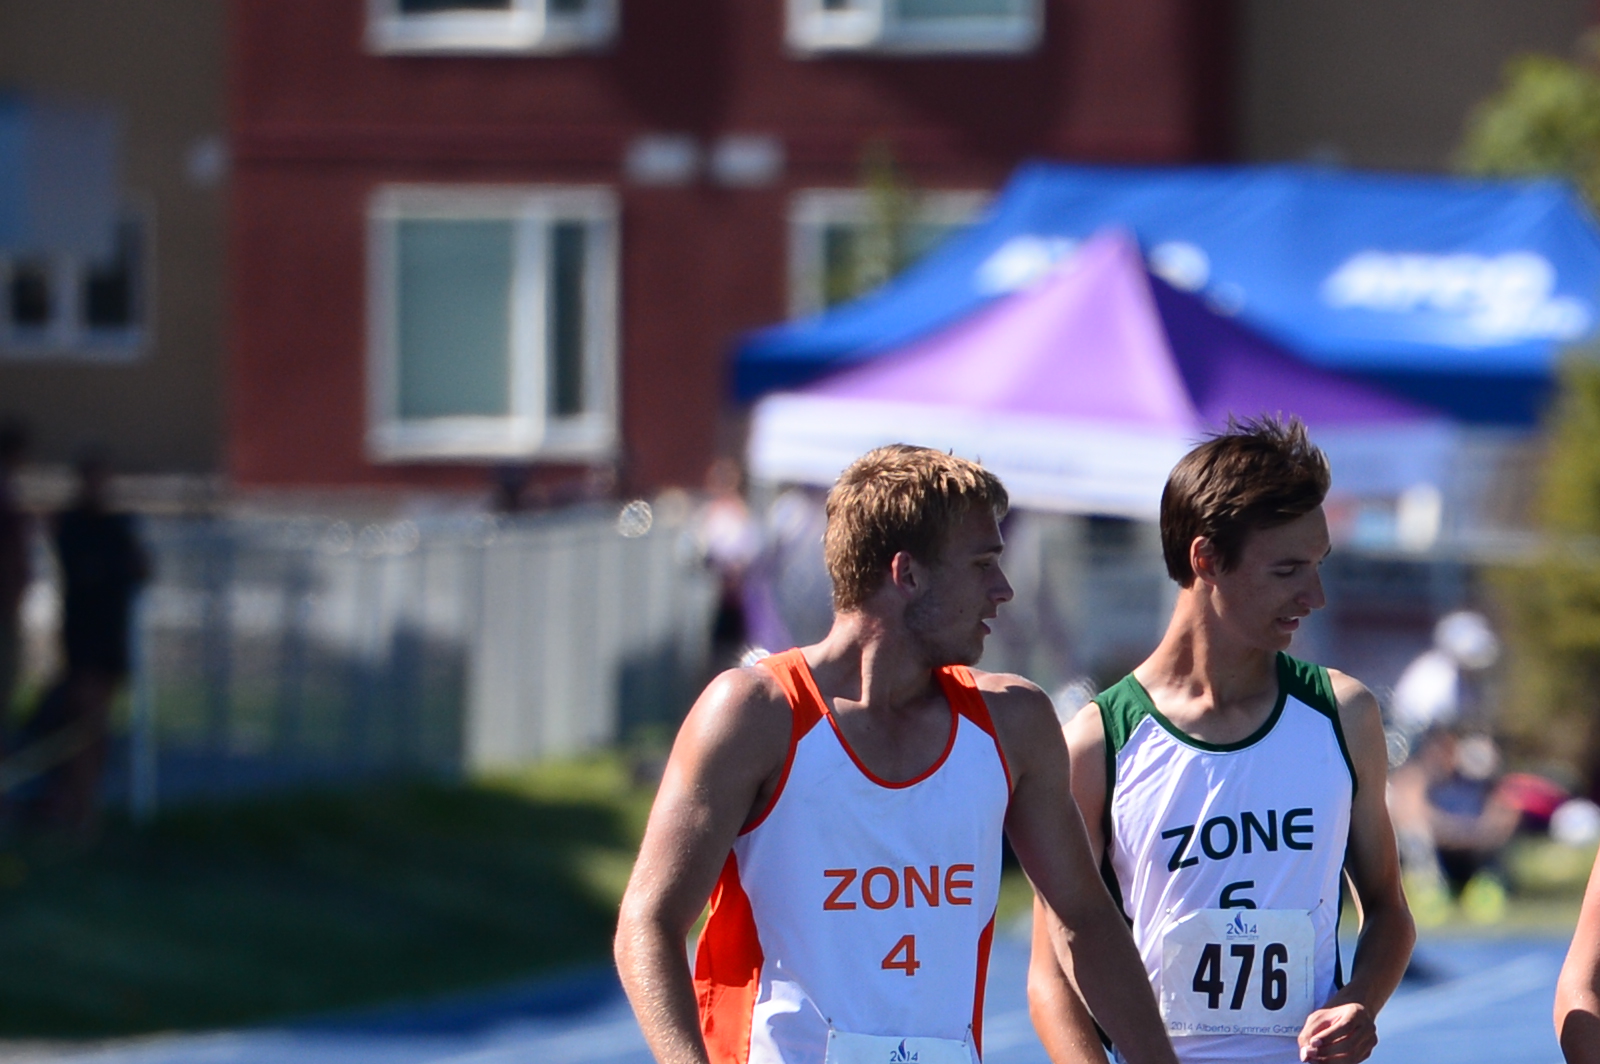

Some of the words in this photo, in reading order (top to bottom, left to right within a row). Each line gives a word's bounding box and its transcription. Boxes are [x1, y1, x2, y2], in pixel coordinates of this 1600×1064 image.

[1161, 807, 1315, 872] ZONE
[823, 863, 976, 911] ZONE
[881, 934, 921, 976] 4
[1192, 942, 1289, 1011] 476
[1195, 1022, 1231, 1033] Alberta
[1233, 1024, 1271, 1034] Summer
